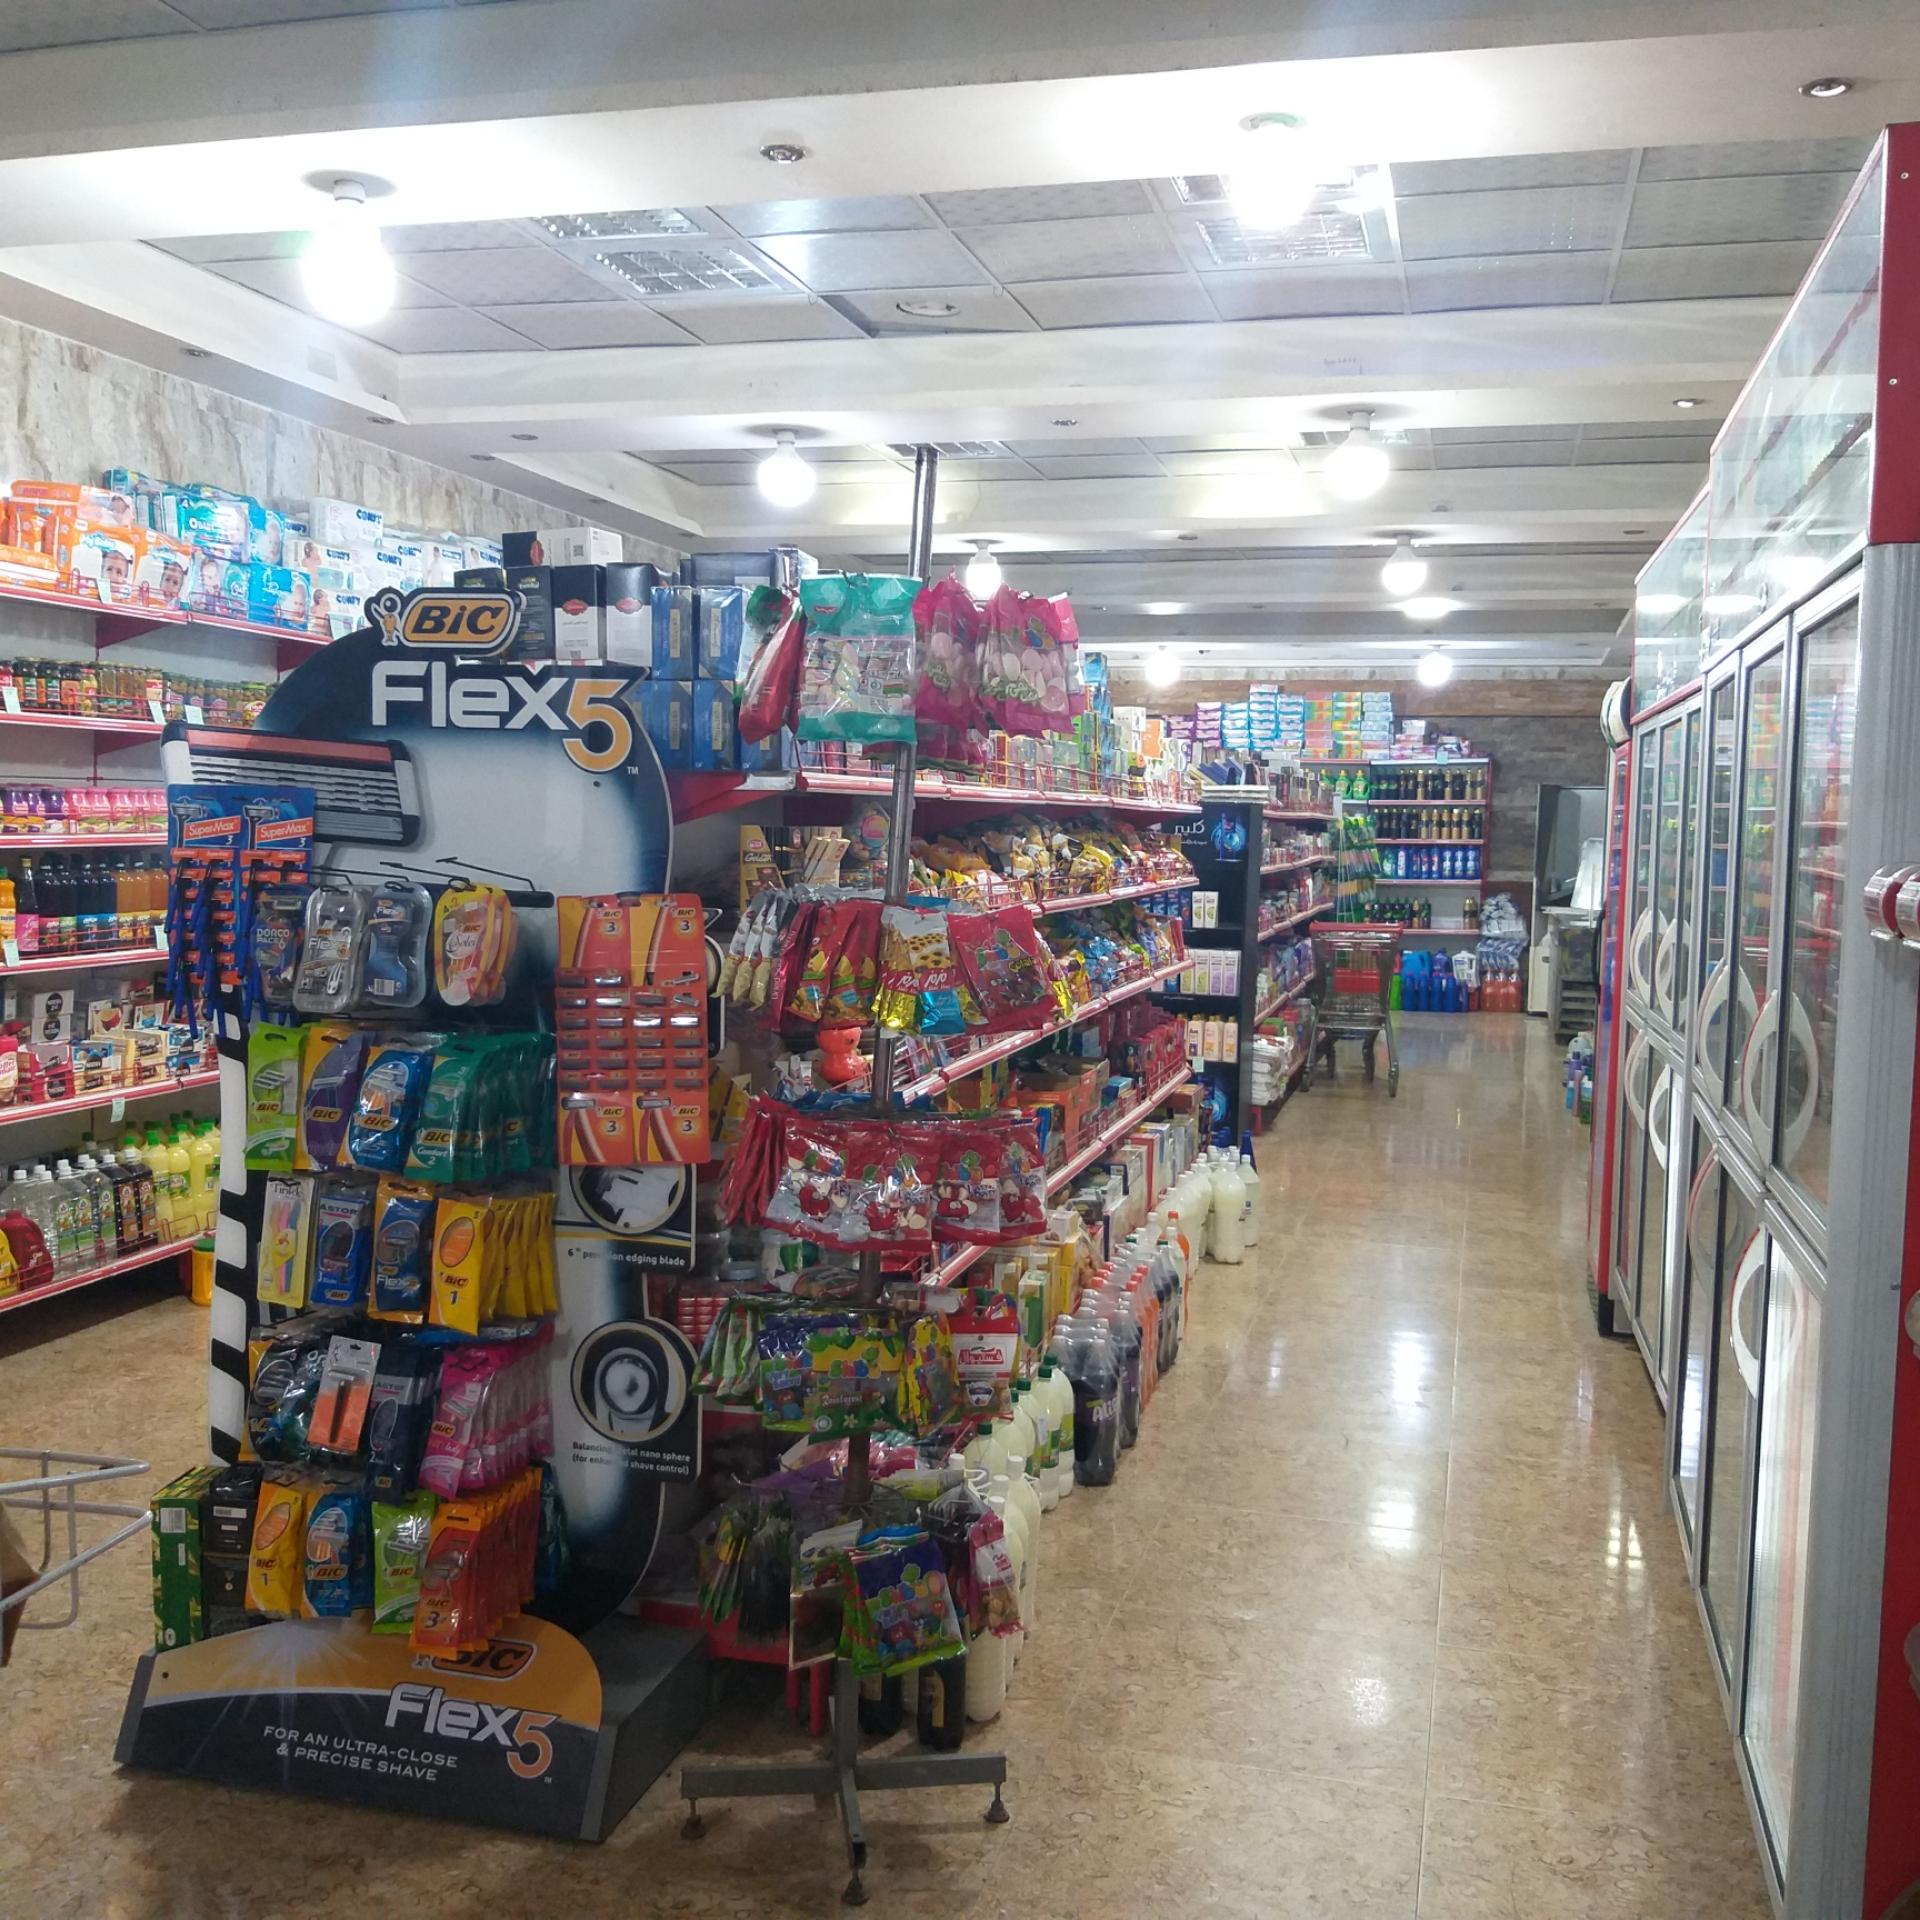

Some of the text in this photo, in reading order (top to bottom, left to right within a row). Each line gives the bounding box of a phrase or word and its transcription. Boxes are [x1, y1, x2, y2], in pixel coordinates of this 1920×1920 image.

[411, 605, 505, 635] BIC
[606, 921, 616, 933] 3
[681, 919, 690, 931] 3
[256, 928, 290, 938] DORCO
[312, 1109, 338, 1120] BIC
[363, 1116, 393, 1129] BIC
[606, 1120, 618, 1133] 3
[681, 1119, 693, 1132] 3
[659, 1254, 686, 1267] blade
[315, 1568, 345, 1578] BIC
[390, 1567, 413, 1577] BIC
[263, 1725, 459, 1769] FOR AN ULTRA-CLOSE
[276, 1742, 438, 1782] & PRECISE SHAVE
